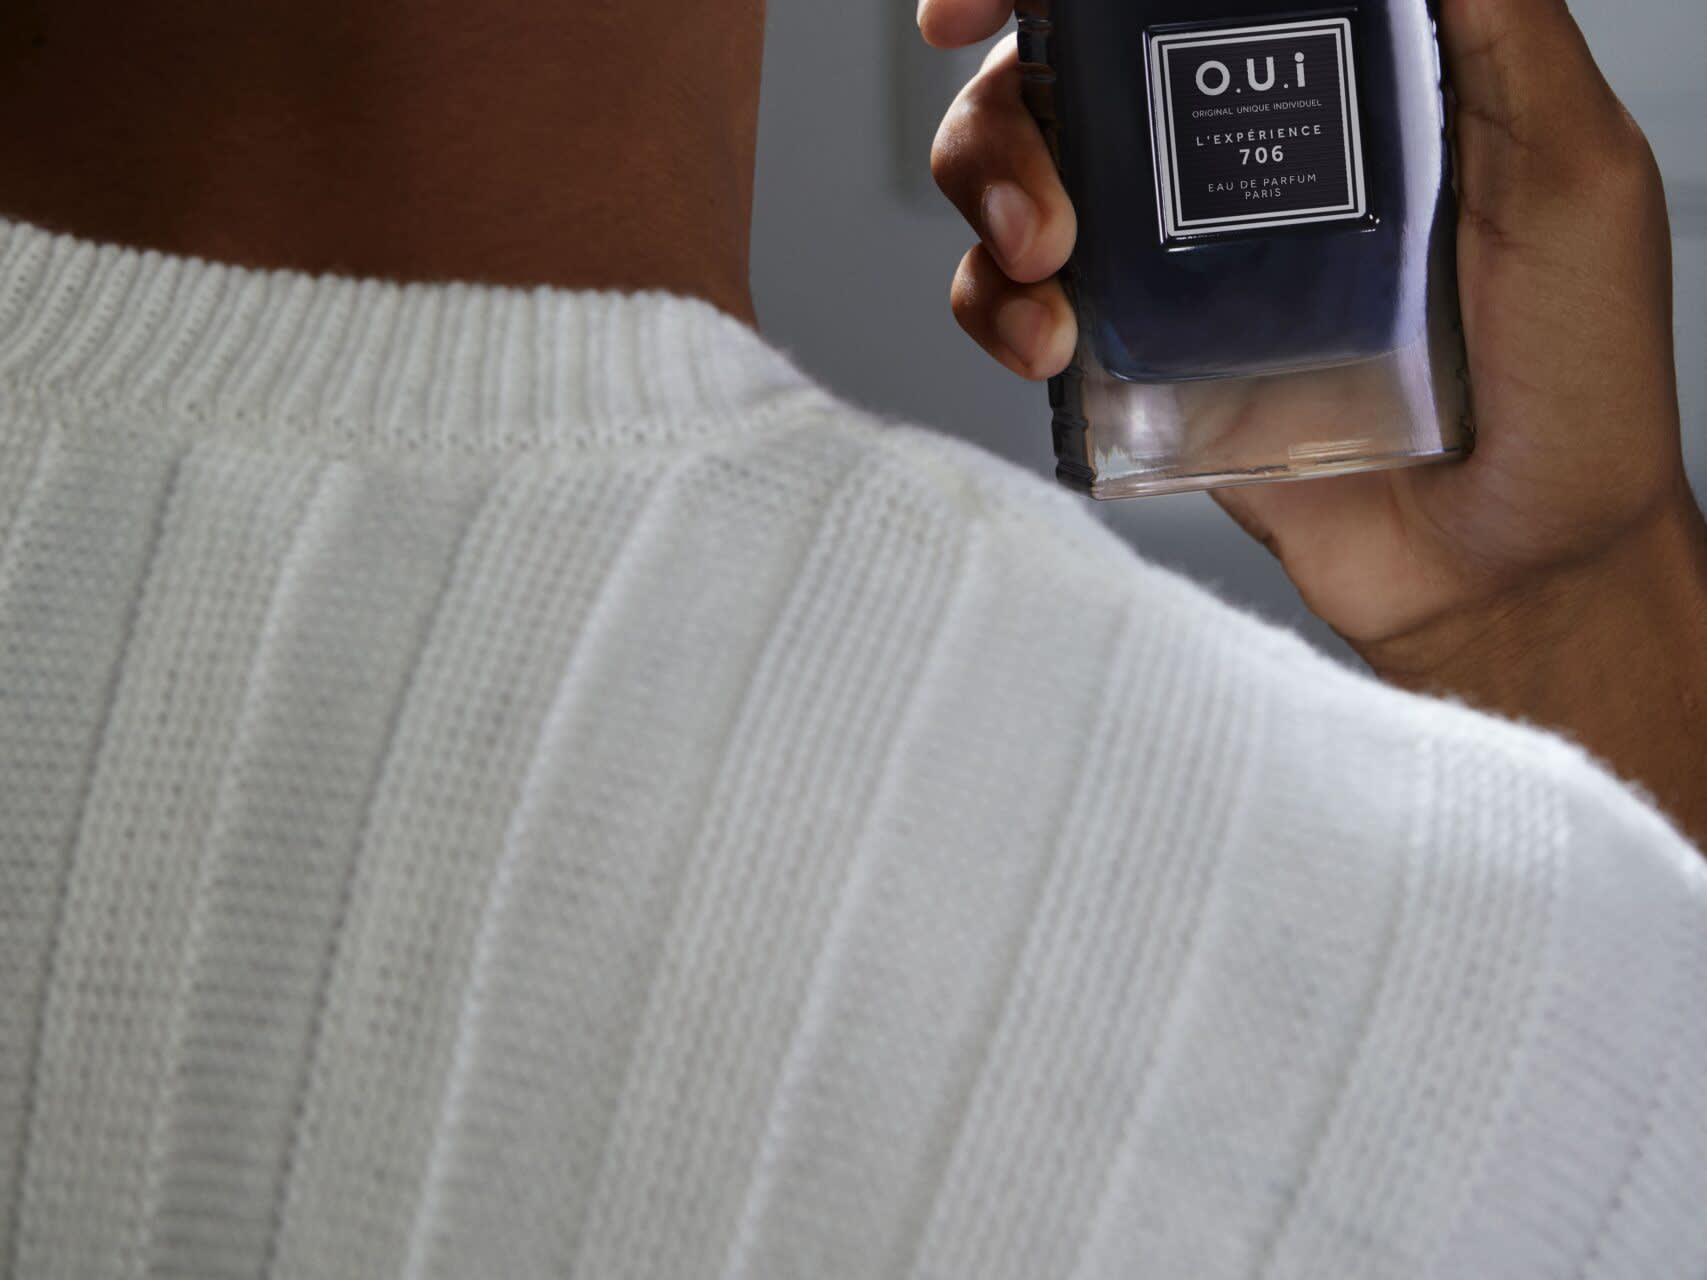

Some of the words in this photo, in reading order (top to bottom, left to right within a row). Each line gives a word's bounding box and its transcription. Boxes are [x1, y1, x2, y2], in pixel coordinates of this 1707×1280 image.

[1195, 52, 1306, 96] O.U.i
[1192, 108, 1234, 119] ORIGINAL
[1236, 104, 1270, 114] UNIQUE
[1273, 99, 1322, 111] INDIVIDUEL
[1196, 124, 1322, 146] L'EXPÉRIENCE
[1239, 145, 1284, 165] 706
[1208, 182, 1234, 193] EAU
[1240, 179, 1257, 189] DE
[1263, 174, 1317, 188] PARFUM
[1245, 188, 1281, 200] PARIS
